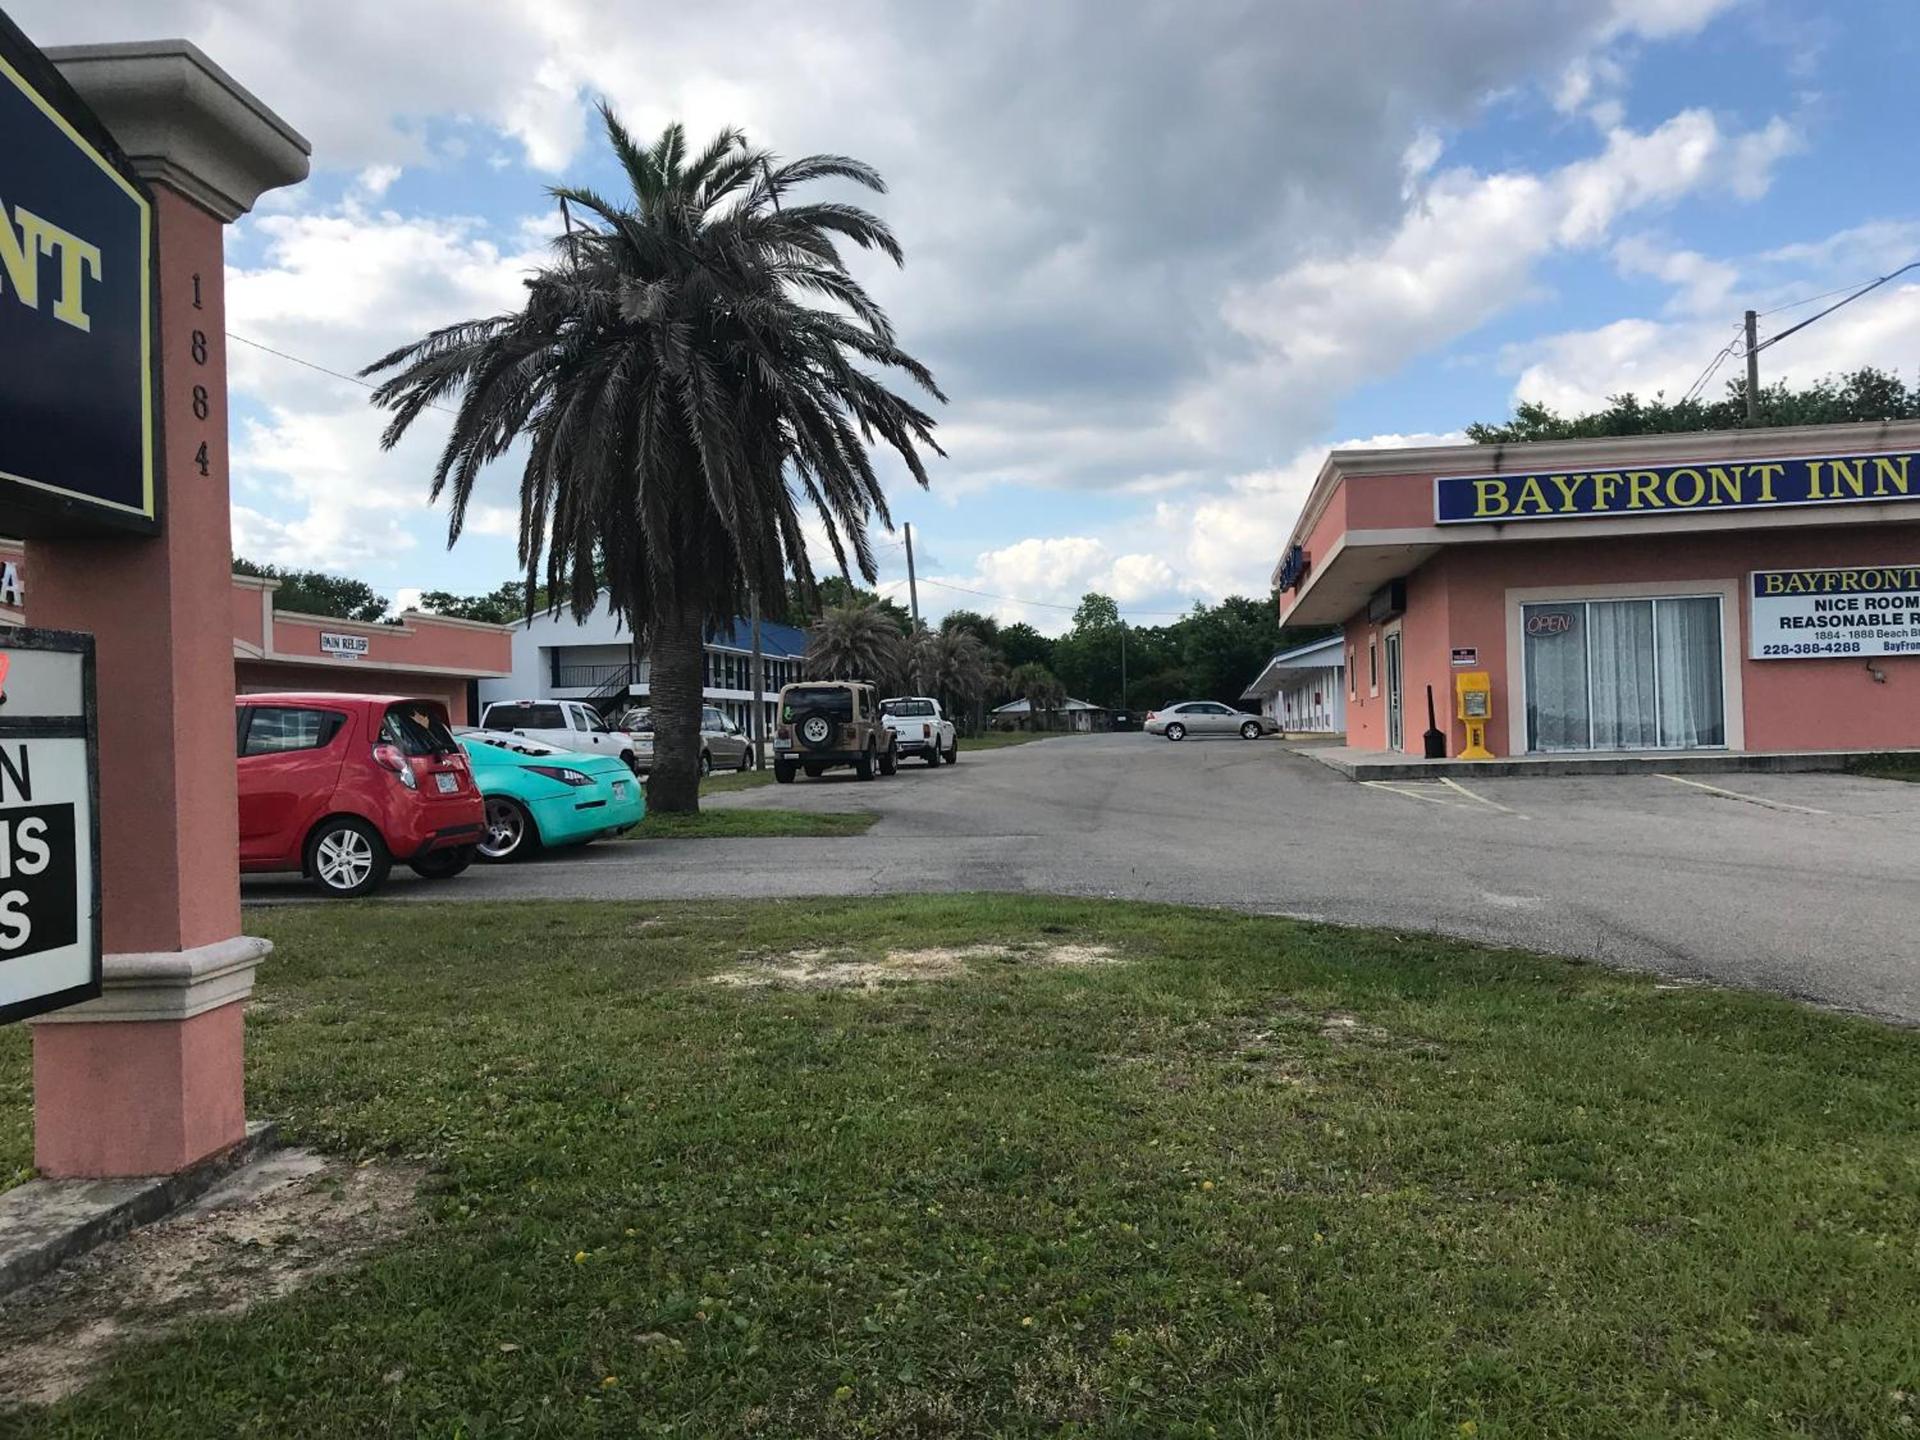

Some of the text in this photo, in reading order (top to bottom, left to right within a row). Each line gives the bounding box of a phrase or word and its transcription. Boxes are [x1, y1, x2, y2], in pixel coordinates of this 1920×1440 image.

[191, 273, 209, 477] 1884
[1472, 456, 1912, 518] BAYFRONT INN
[1764, 568, 1920, 595] BAYFRONT
[1814, 598, 1859, 612] NICE
[1527, 615, 1570, 633] OPEN
[1779, 612, 1904, 629] REASONABLE
[1876, 629, 1909, 639] Beach
[1763, 641, 1861, 656] 228-388-4288
